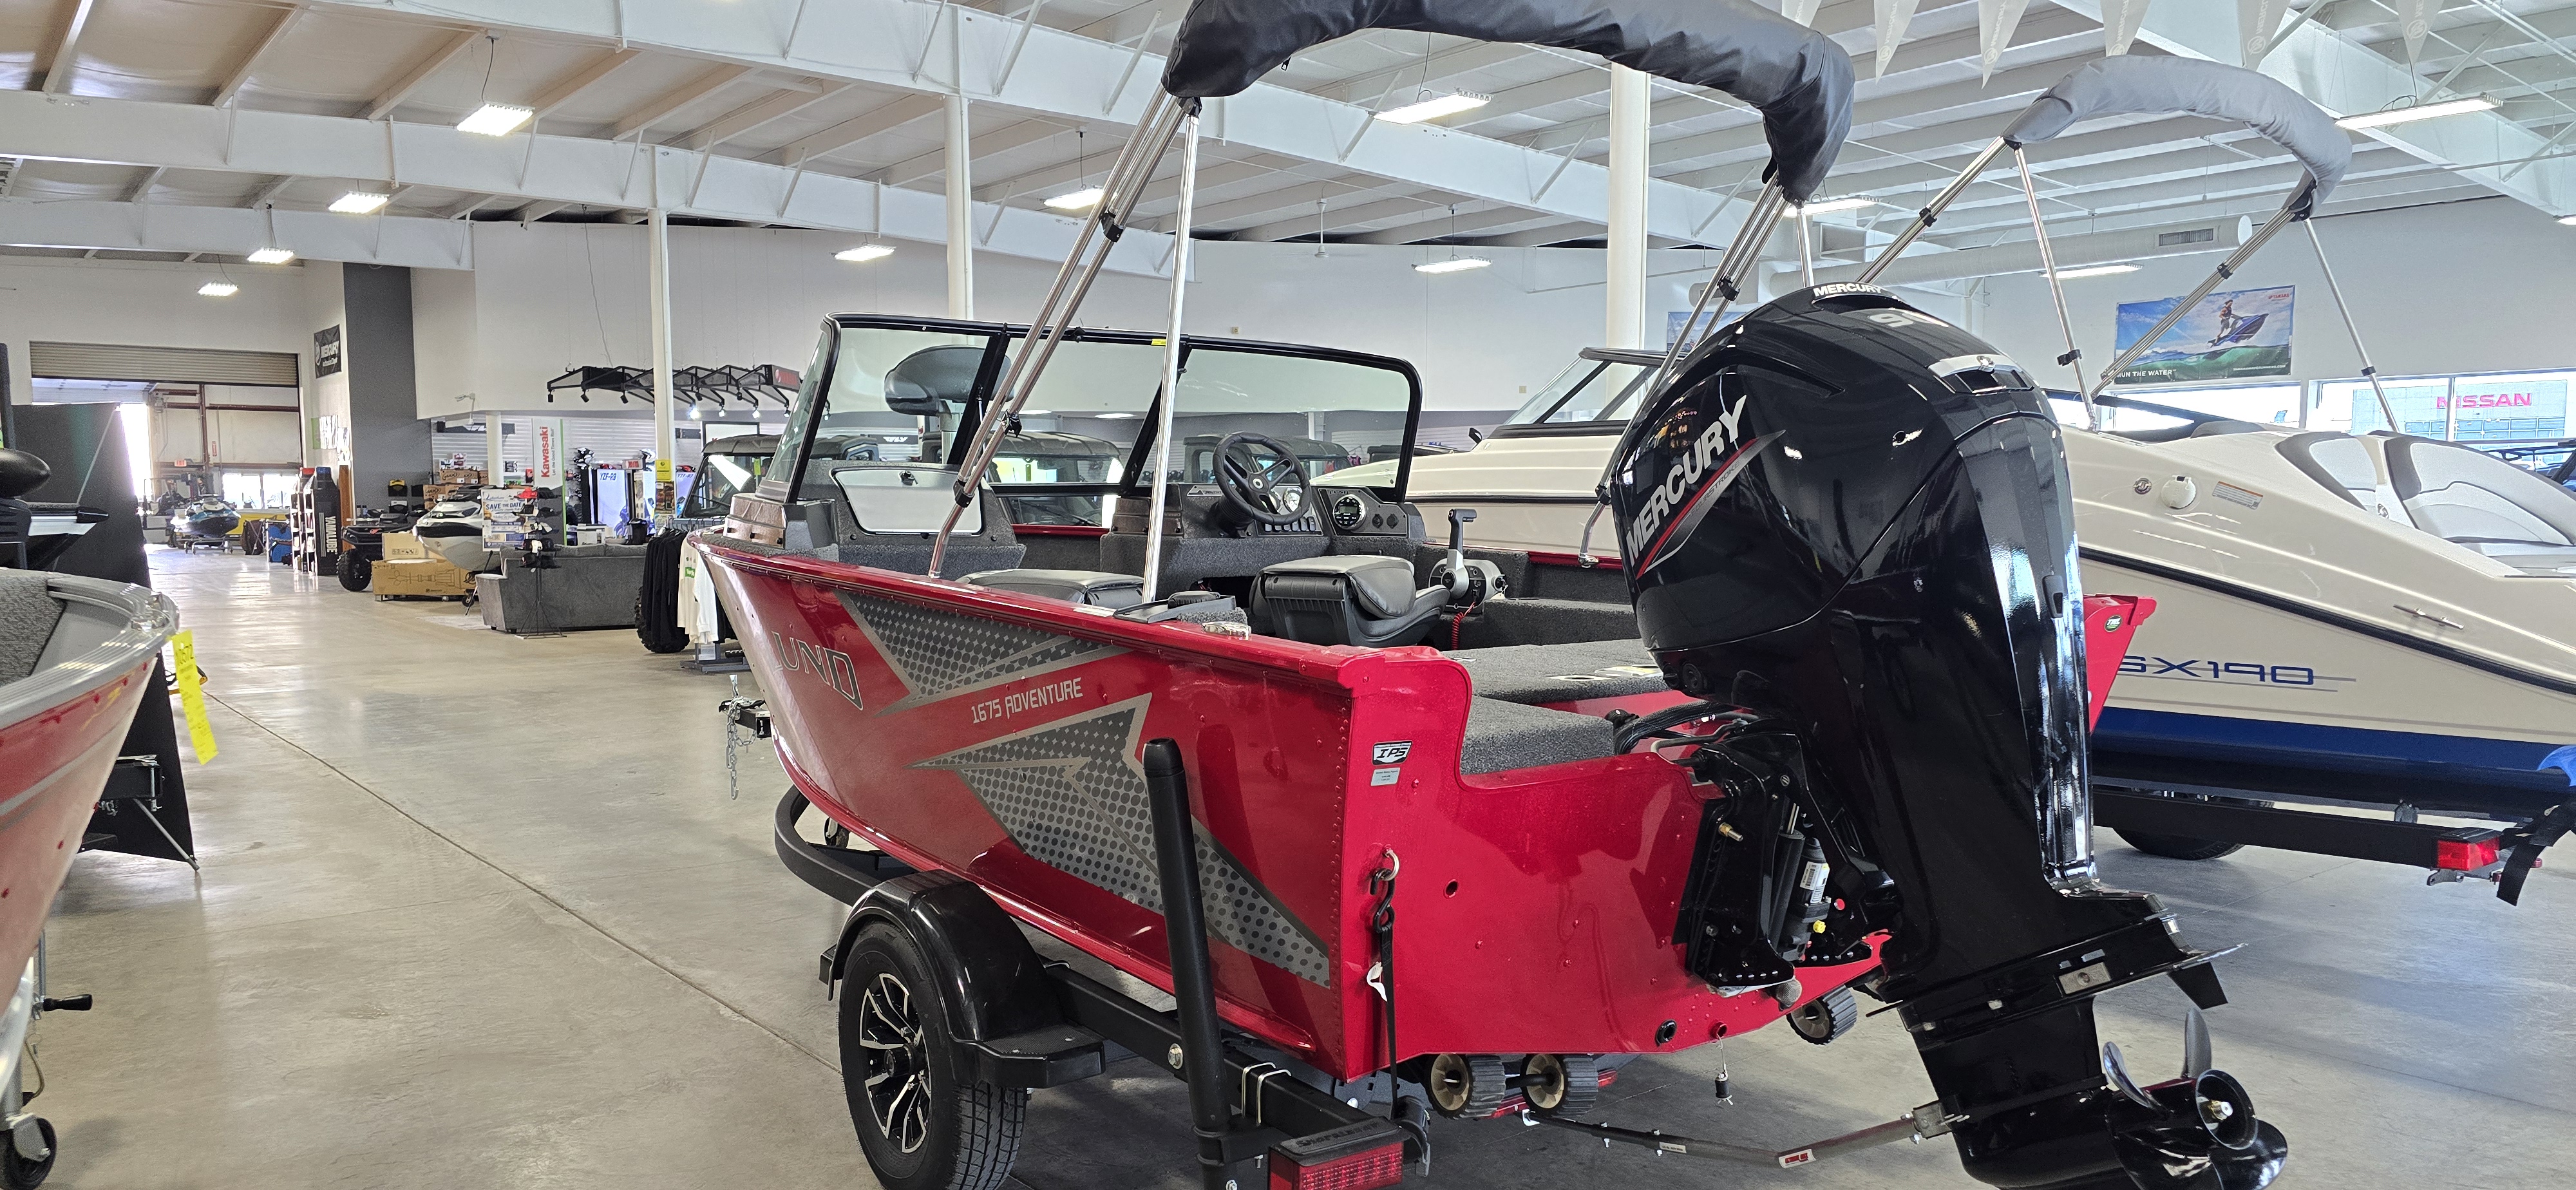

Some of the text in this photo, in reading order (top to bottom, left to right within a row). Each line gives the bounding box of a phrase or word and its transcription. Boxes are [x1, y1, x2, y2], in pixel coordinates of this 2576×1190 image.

[1813, 283, 1882, 297] MERCURY
[2437, 393, 2532, 409] NISSAN
[540, 426, 550, 478] Kawasaki
[1625, 395, 1747, 568] MERCURY
[2118, 655, 2314, 685] SX190
[971, 677, 1083, 724] 1675 ADVENTURE
[1376, 747, 1408, 759] IPS
